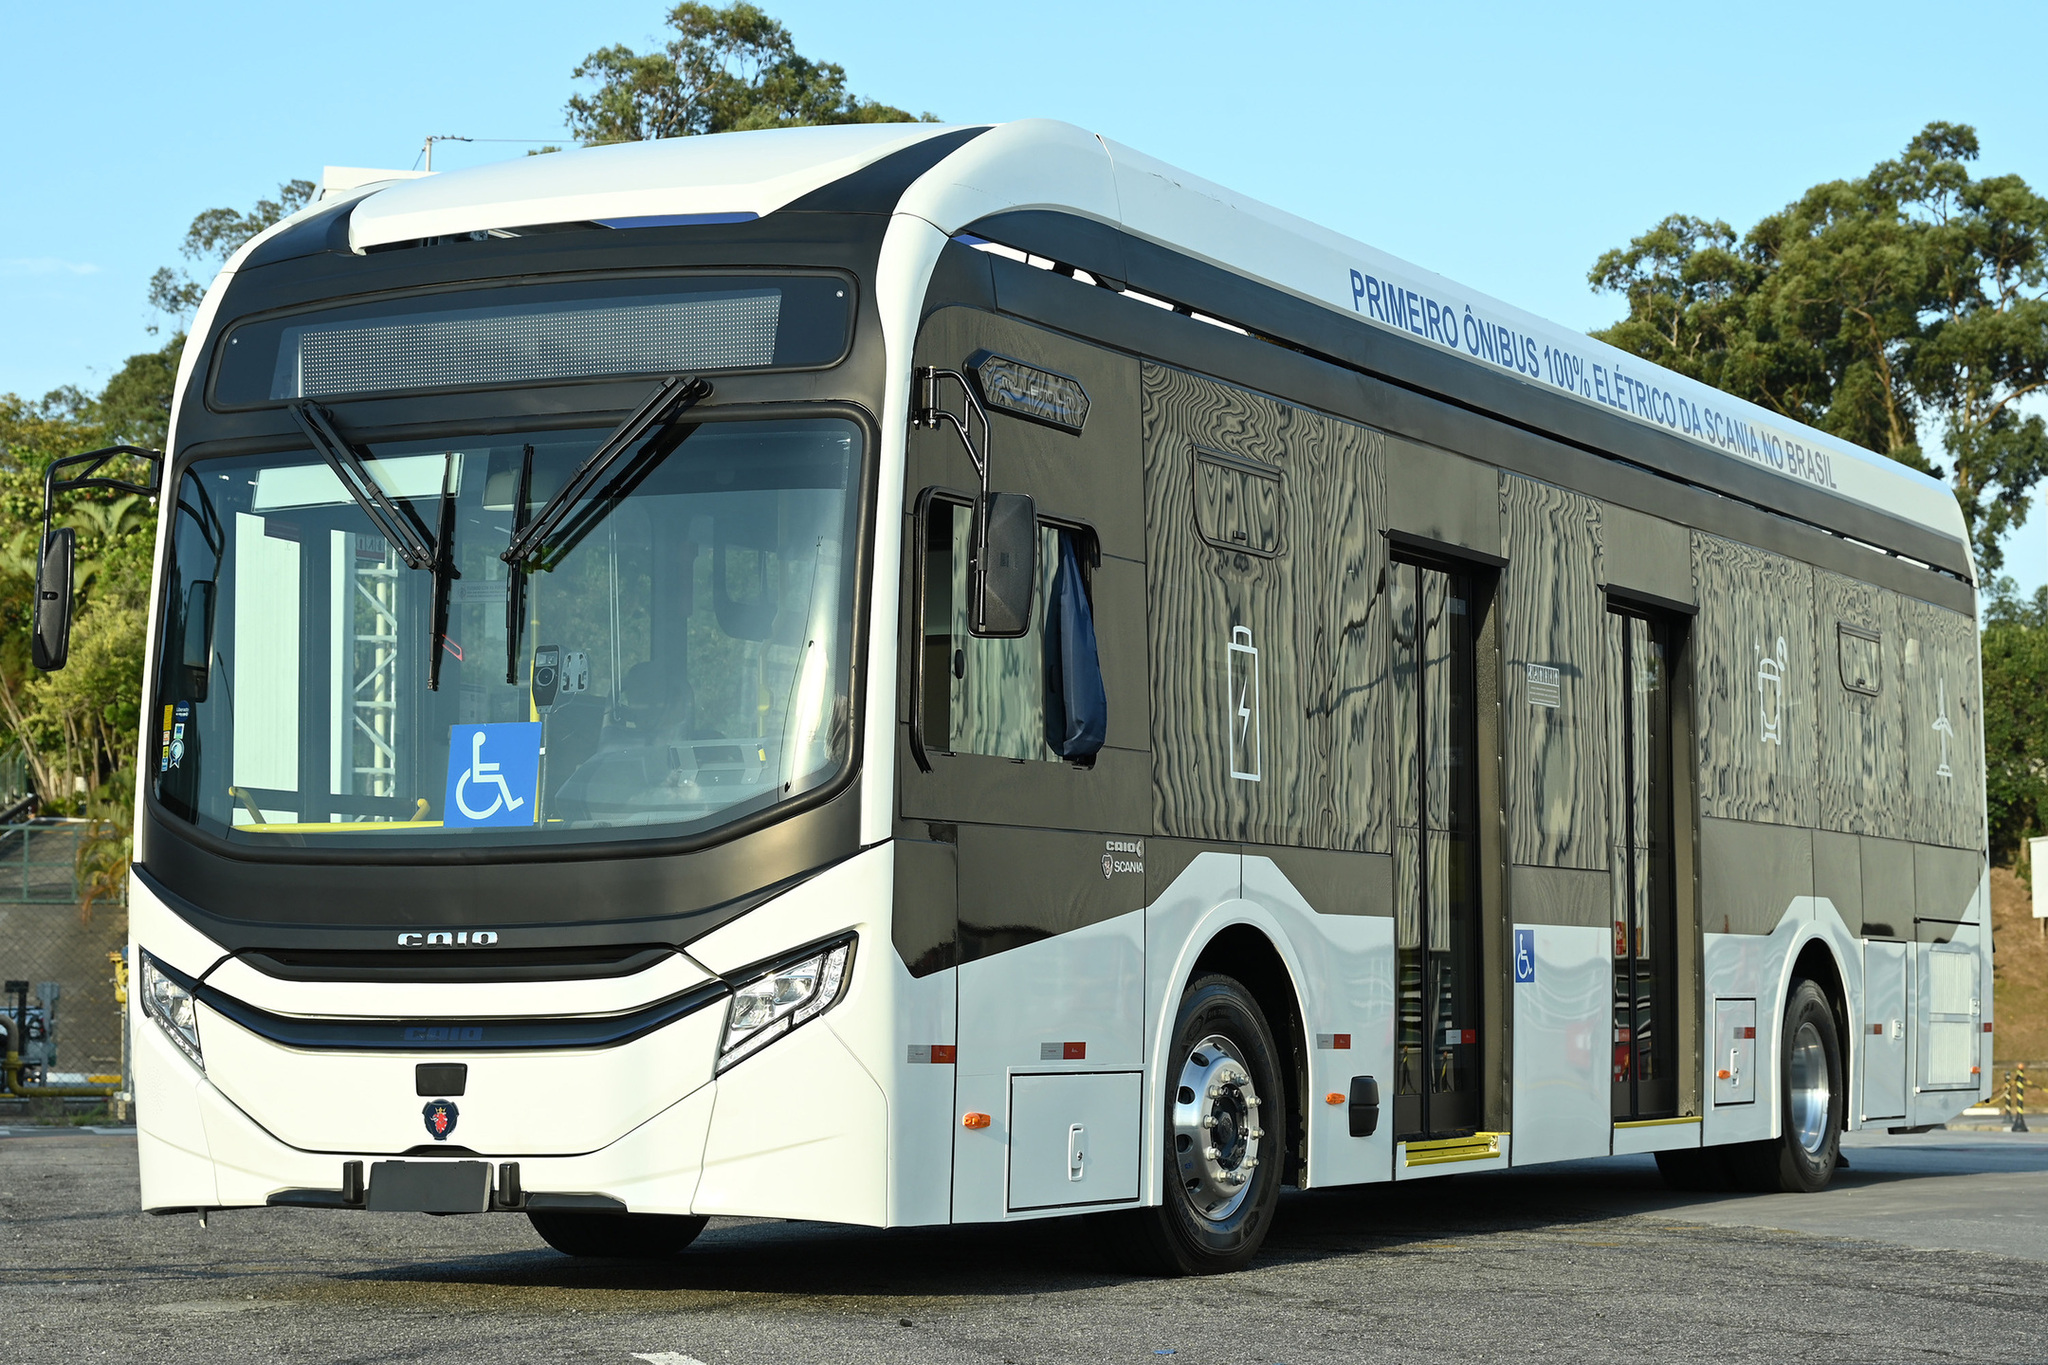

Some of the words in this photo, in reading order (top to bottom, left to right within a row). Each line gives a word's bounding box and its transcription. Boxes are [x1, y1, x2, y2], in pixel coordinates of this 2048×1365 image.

[1349, 268, 1459, 348] PRIMEIRO
[1463, 304, 1540, 378] ÔNIBUS
[1543, 345, 1591, 398] 100%
[1592, 363, 1677, 429] ELÉTRICO
[1678, 397, 1704, 440] DA
[1704, 407, 1761, 462] SCANIA
[1761, 430, 1784, 470] NO
[1785, 440, 1837, 489] BRASIL
[1106, 841, 1136, 853] CAIO
[1114, 861, 1144, 873] SCANIA
[397, 931, 498, 947] CAIO
[404, 1026, 483, 1041] CAIO
